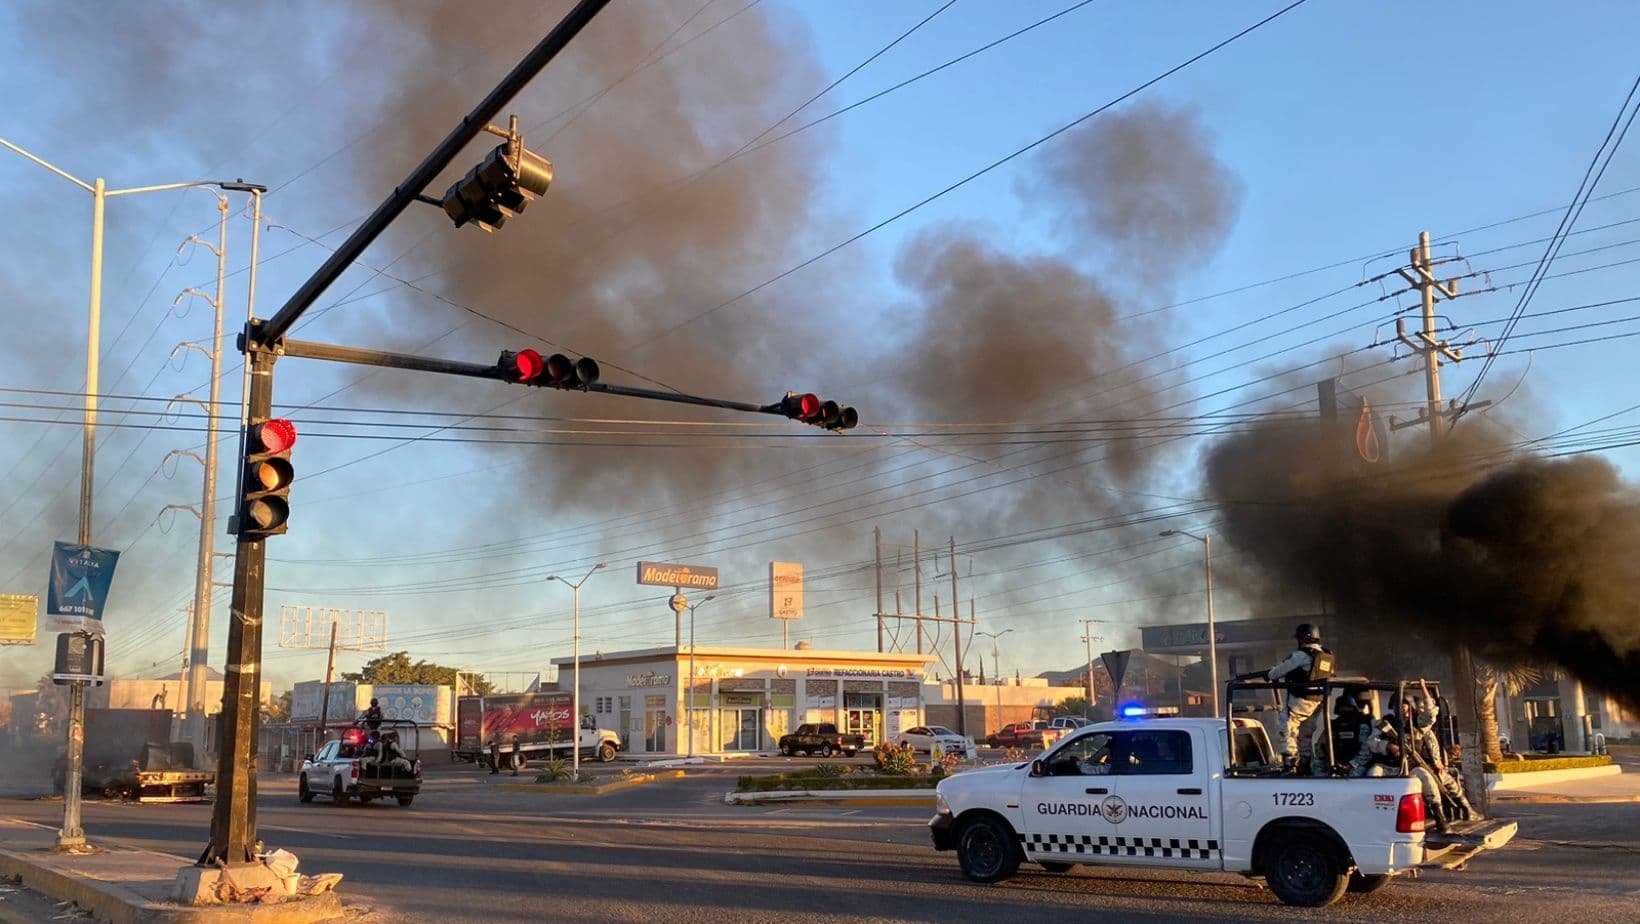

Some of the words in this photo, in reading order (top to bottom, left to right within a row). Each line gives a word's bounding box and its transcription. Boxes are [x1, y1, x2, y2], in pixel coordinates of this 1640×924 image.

[833, 668, 880, 678] REFACCIONARIA
[881, 669, 905, 678] CASTRO
[1272, 792, 1315, 806] 17223
[1037, 802, 1102, 817] GUARDIA
[1128, 805, 1208, 819] NACIONAL
